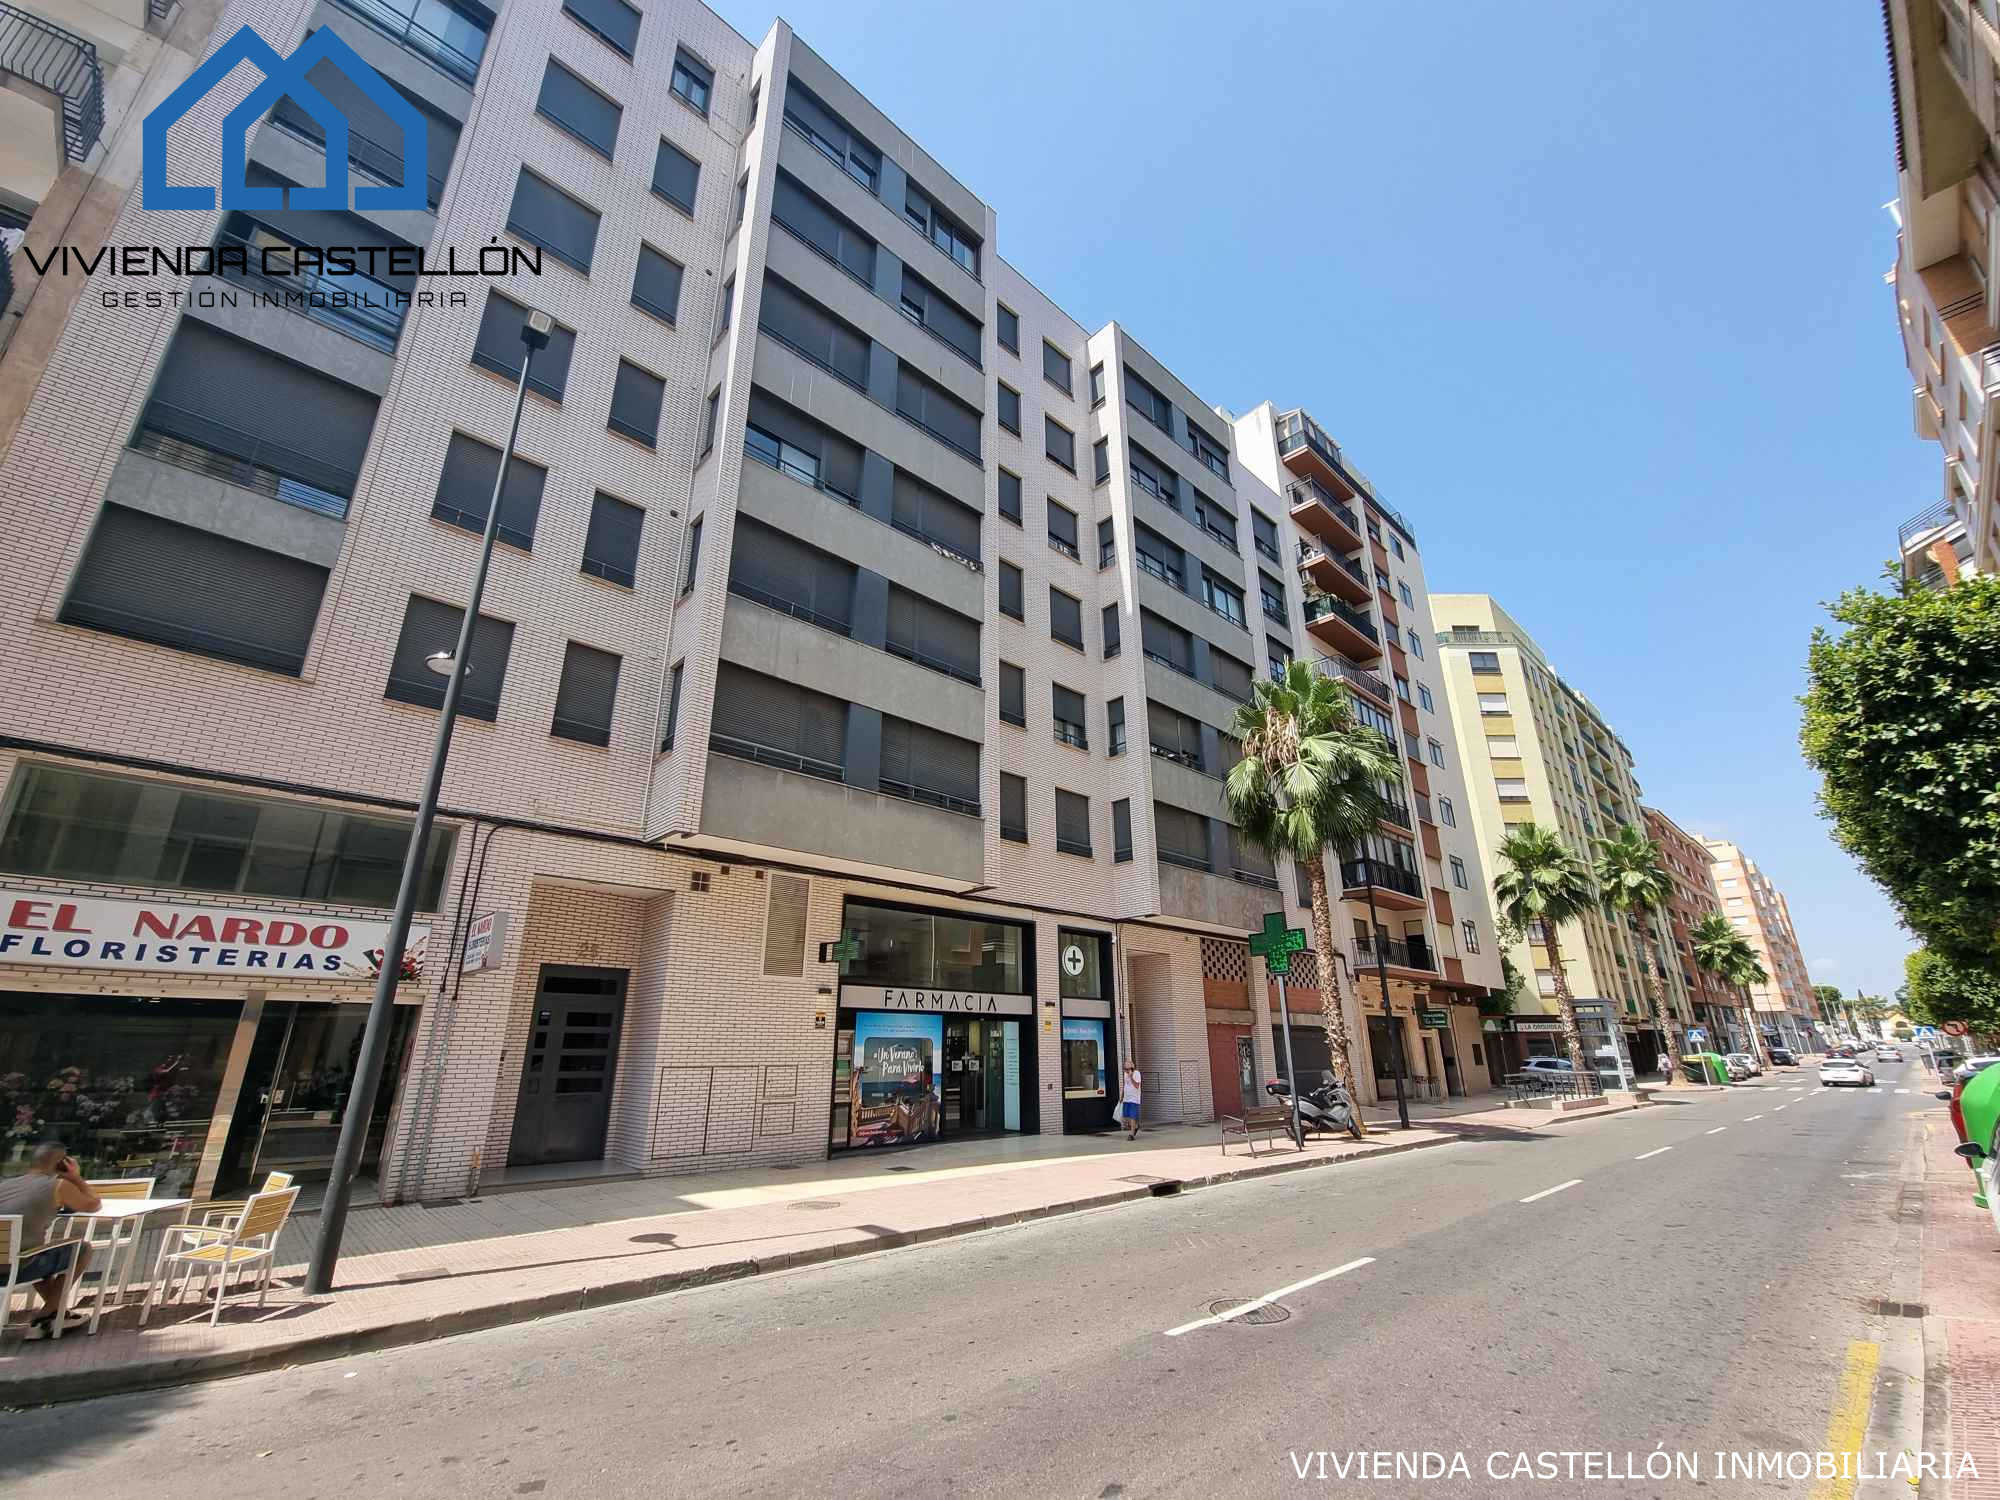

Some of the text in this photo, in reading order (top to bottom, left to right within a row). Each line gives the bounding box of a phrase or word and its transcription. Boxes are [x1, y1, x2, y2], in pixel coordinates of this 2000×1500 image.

[8, 899, 350, 950] EL NARDO
[0, 934, 343, 972] FLORISTERIAS
[883, 990, 997, 1013] FARMACIA
[882, 1061, 902, 1077] Para
